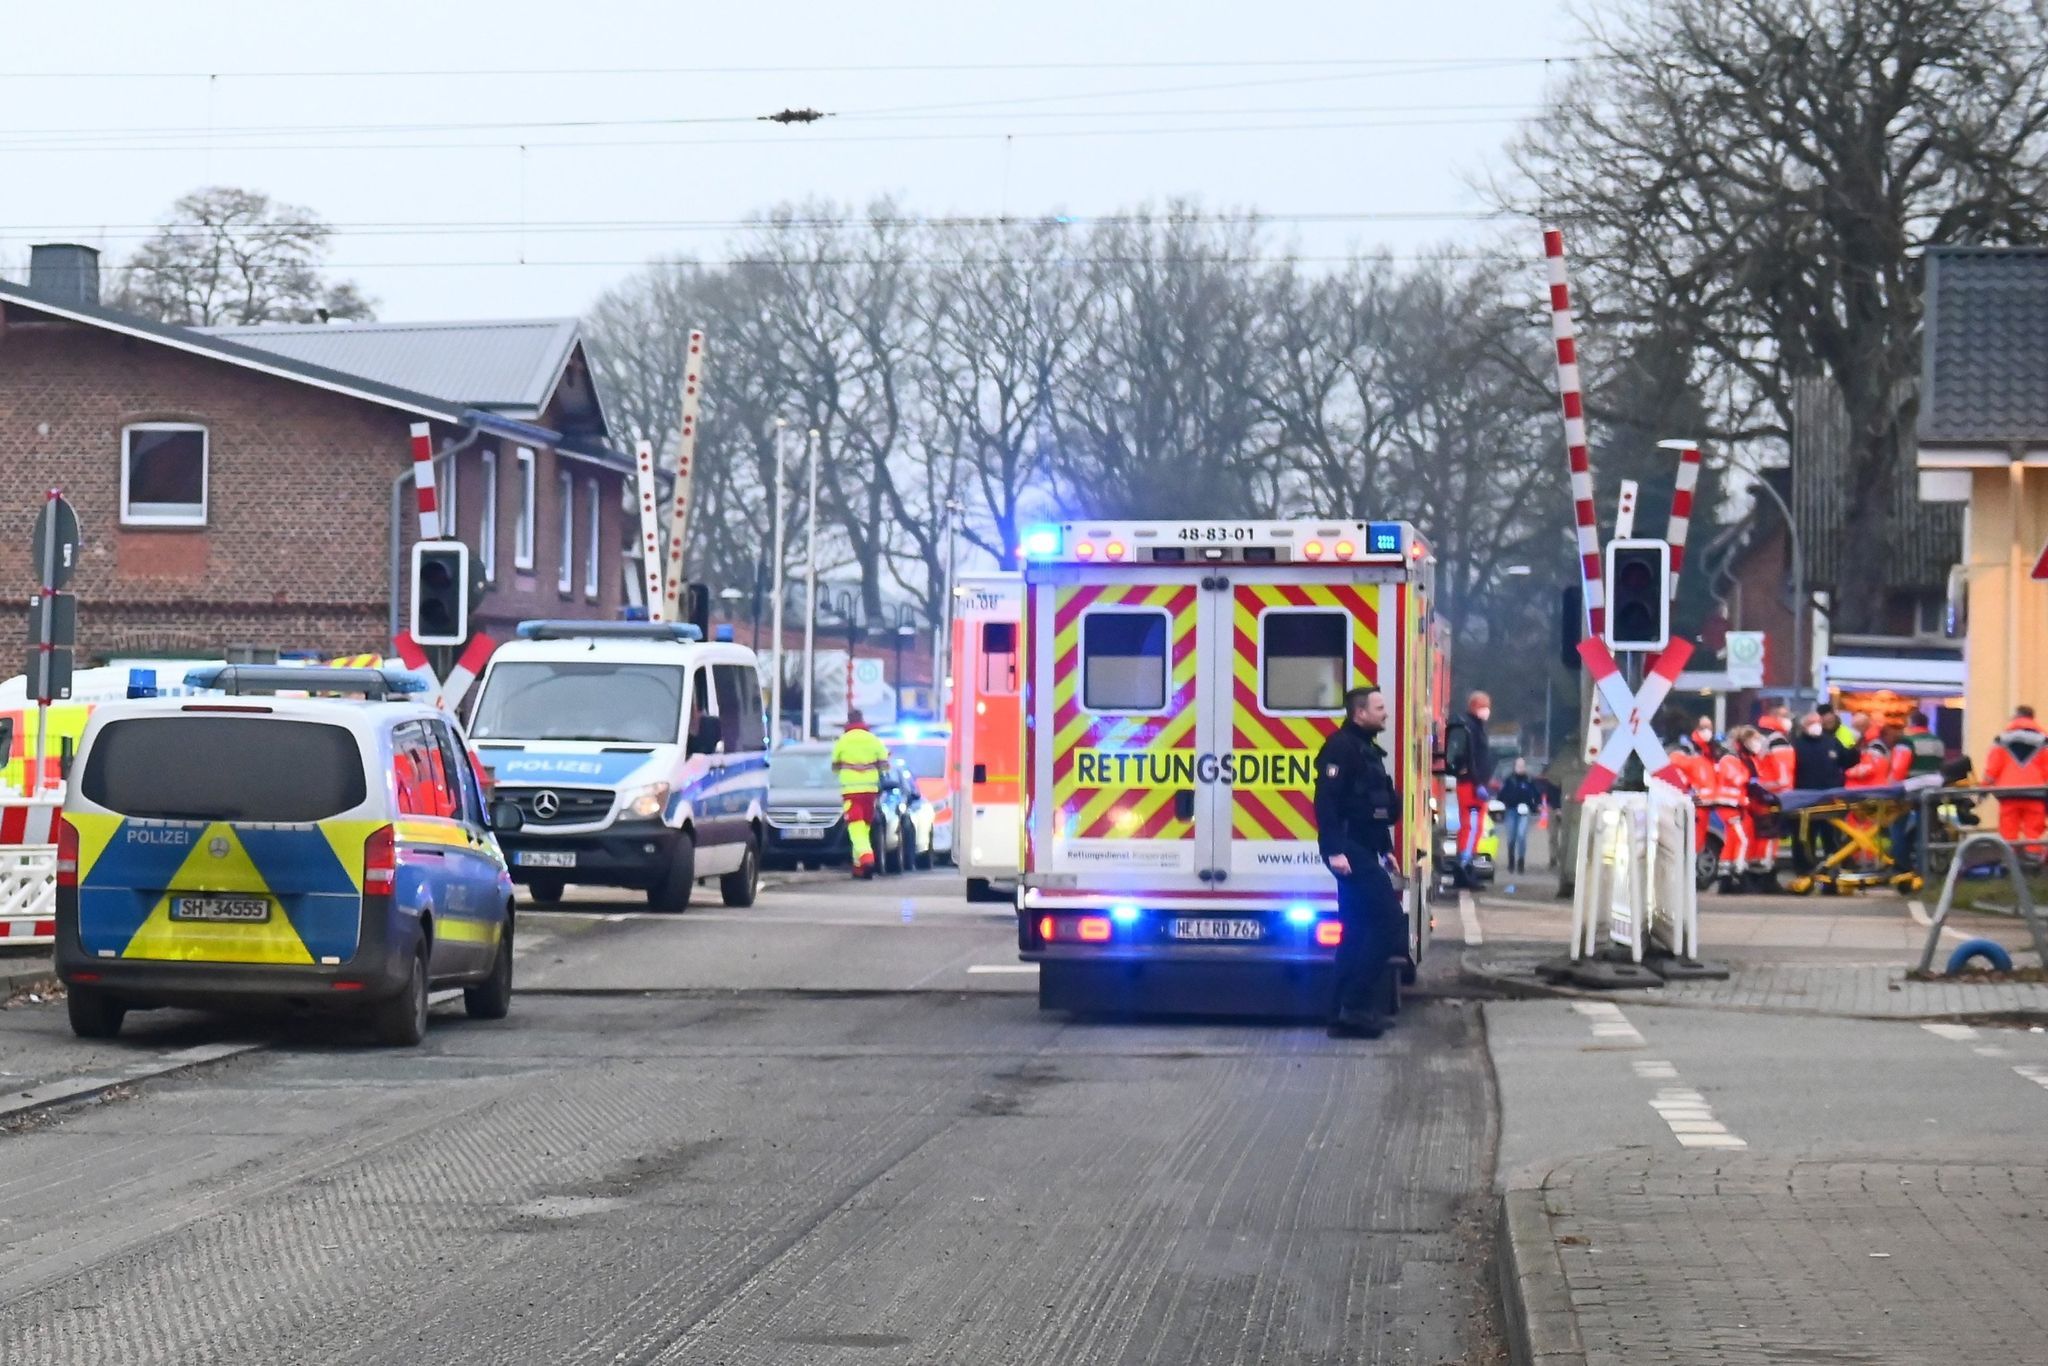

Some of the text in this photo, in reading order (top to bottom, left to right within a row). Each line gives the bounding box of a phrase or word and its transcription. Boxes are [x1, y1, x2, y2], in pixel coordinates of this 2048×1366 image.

[1178, 527, 1254, 541] 48-83-01
[506, 760, 602, 775] POLIZEI
[1078, 753, 1318, 785] RETTUNGSDIEN
[127, 830, 189, 844] POLIZEI
[1257, 851, 1322, 864] www.rkis
[181, 899, 263, 917] SH 34555
[1233, 922, 1258, 937] 762
